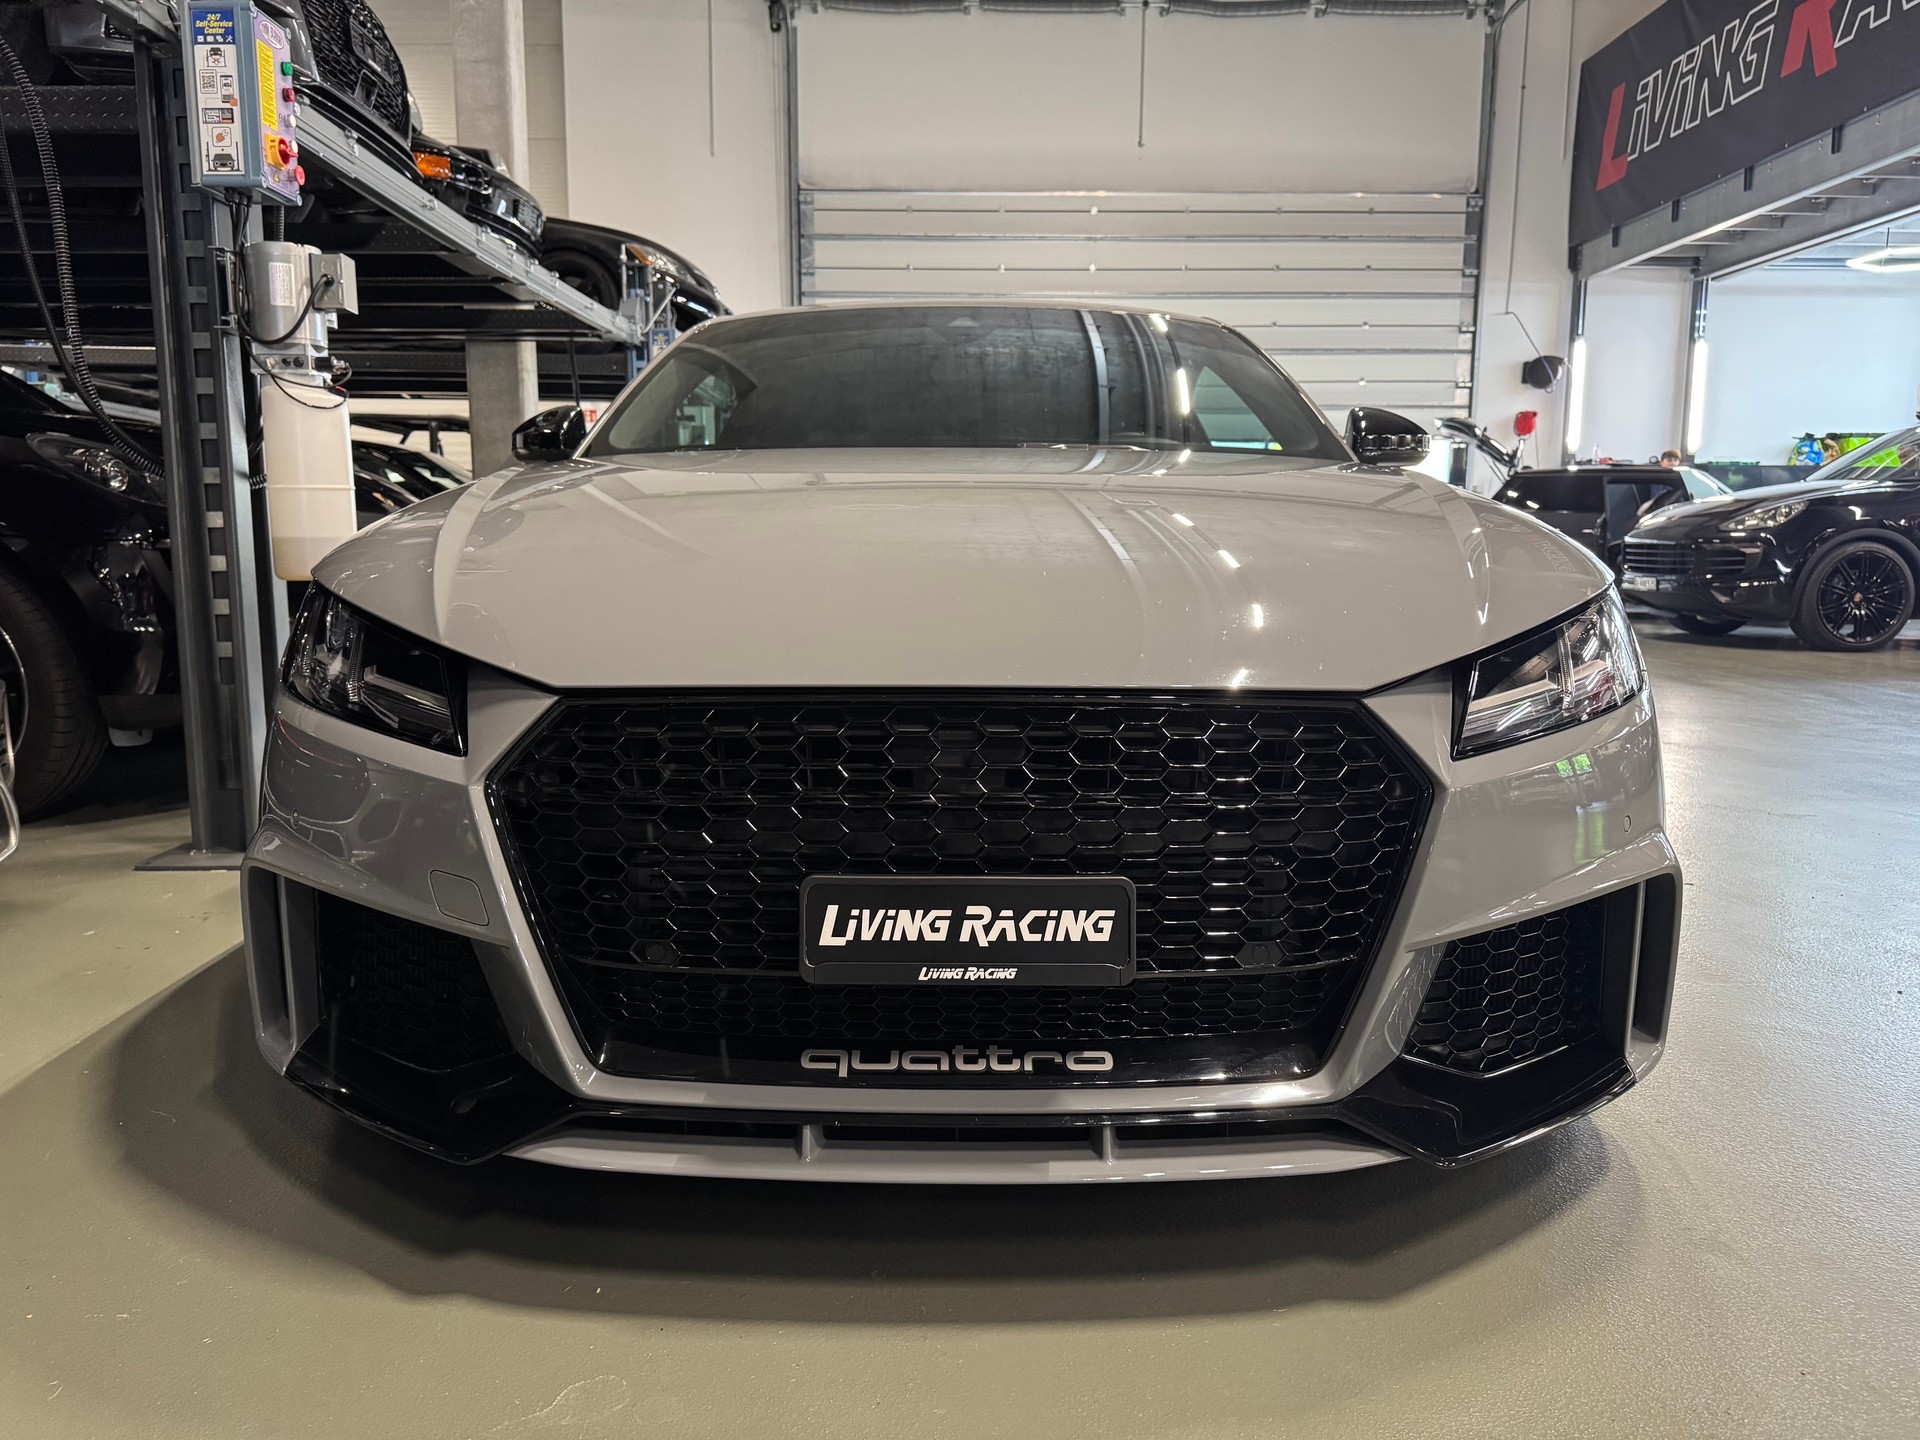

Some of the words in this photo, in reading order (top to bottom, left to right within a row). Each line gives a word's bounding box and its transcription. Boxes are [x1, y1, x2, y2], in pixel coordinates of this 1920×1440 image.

[206, 13, 221, 21] 24/7
[195, 20, 233, 28] Self-Service
[800, 1045, 1114, 1078] quattro
